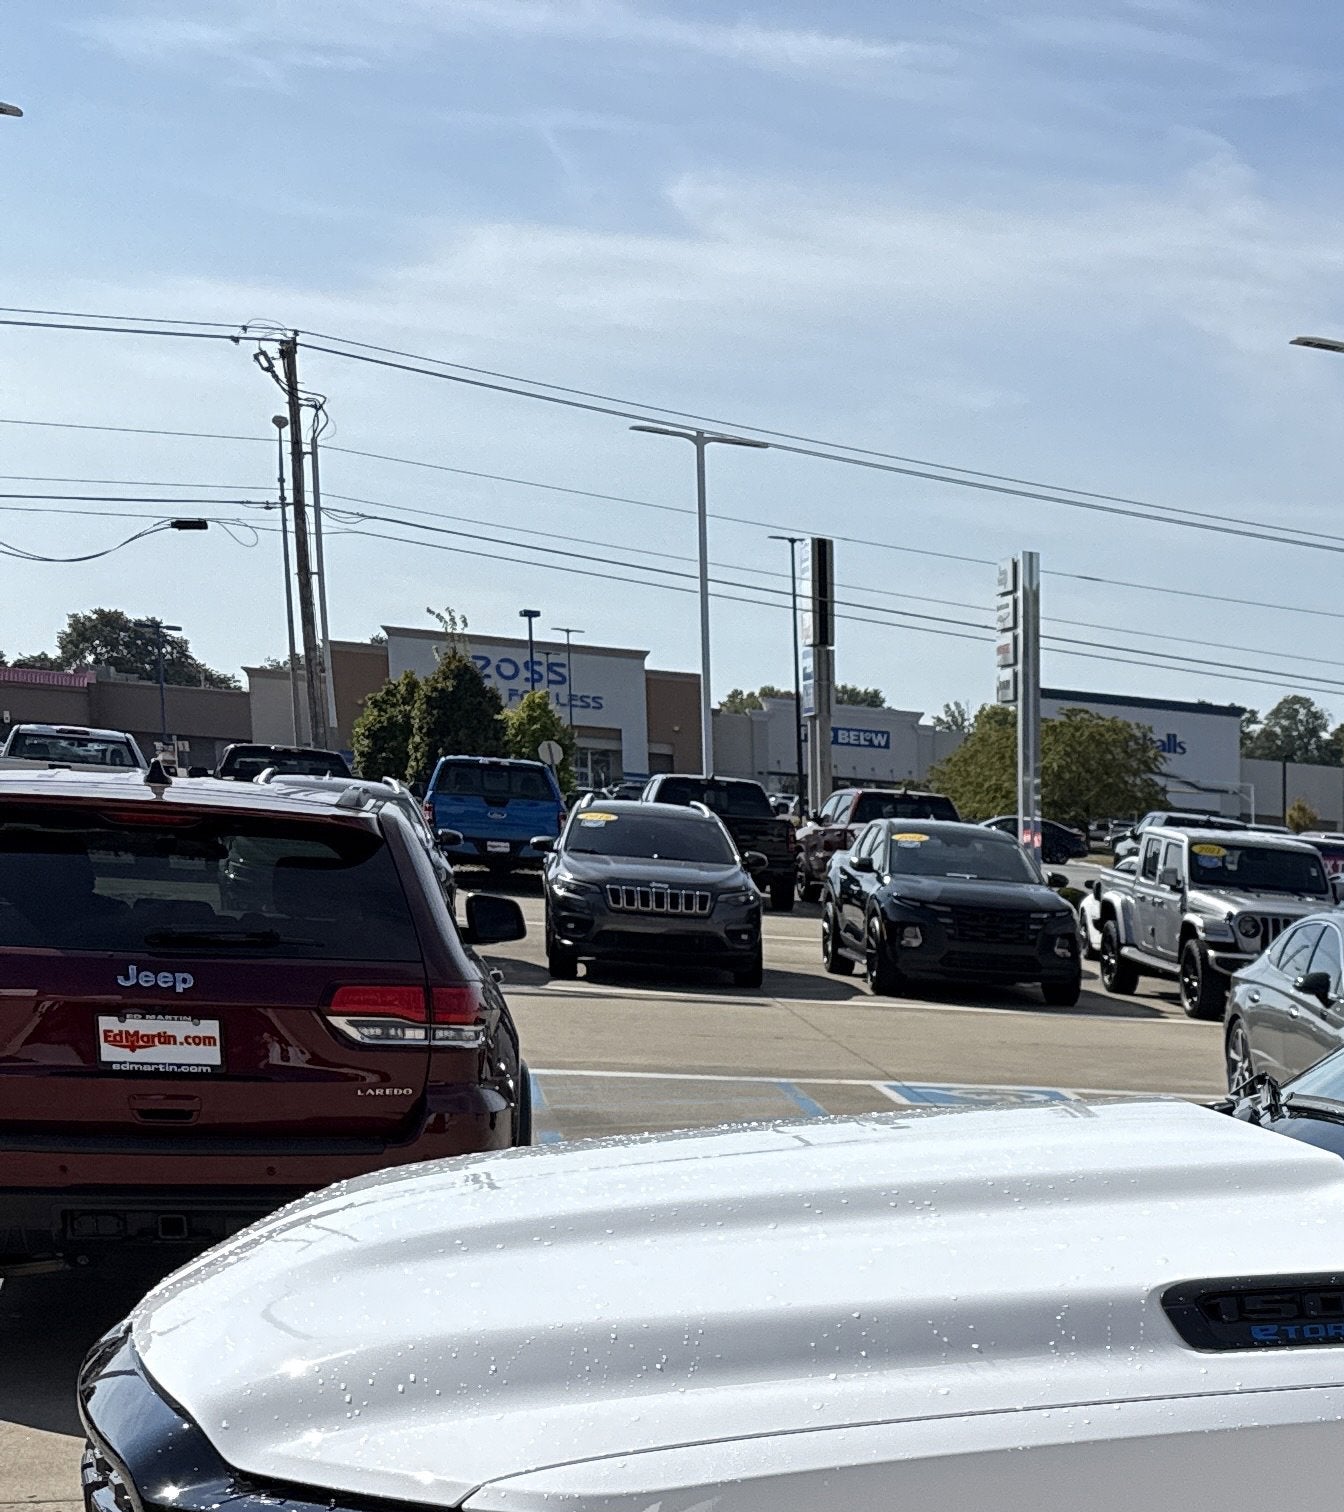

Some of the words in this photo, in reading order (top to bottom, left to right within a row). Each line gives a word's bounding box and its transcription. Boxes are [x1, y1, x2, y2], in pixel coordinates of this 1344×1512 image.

[555, 691, 604, 710] LESS
[116, 964, 195, 993] Jeep
[111, 1061, 212, 1074] edmartin.com
[356, 1086, 413, 1096] LAREDO
